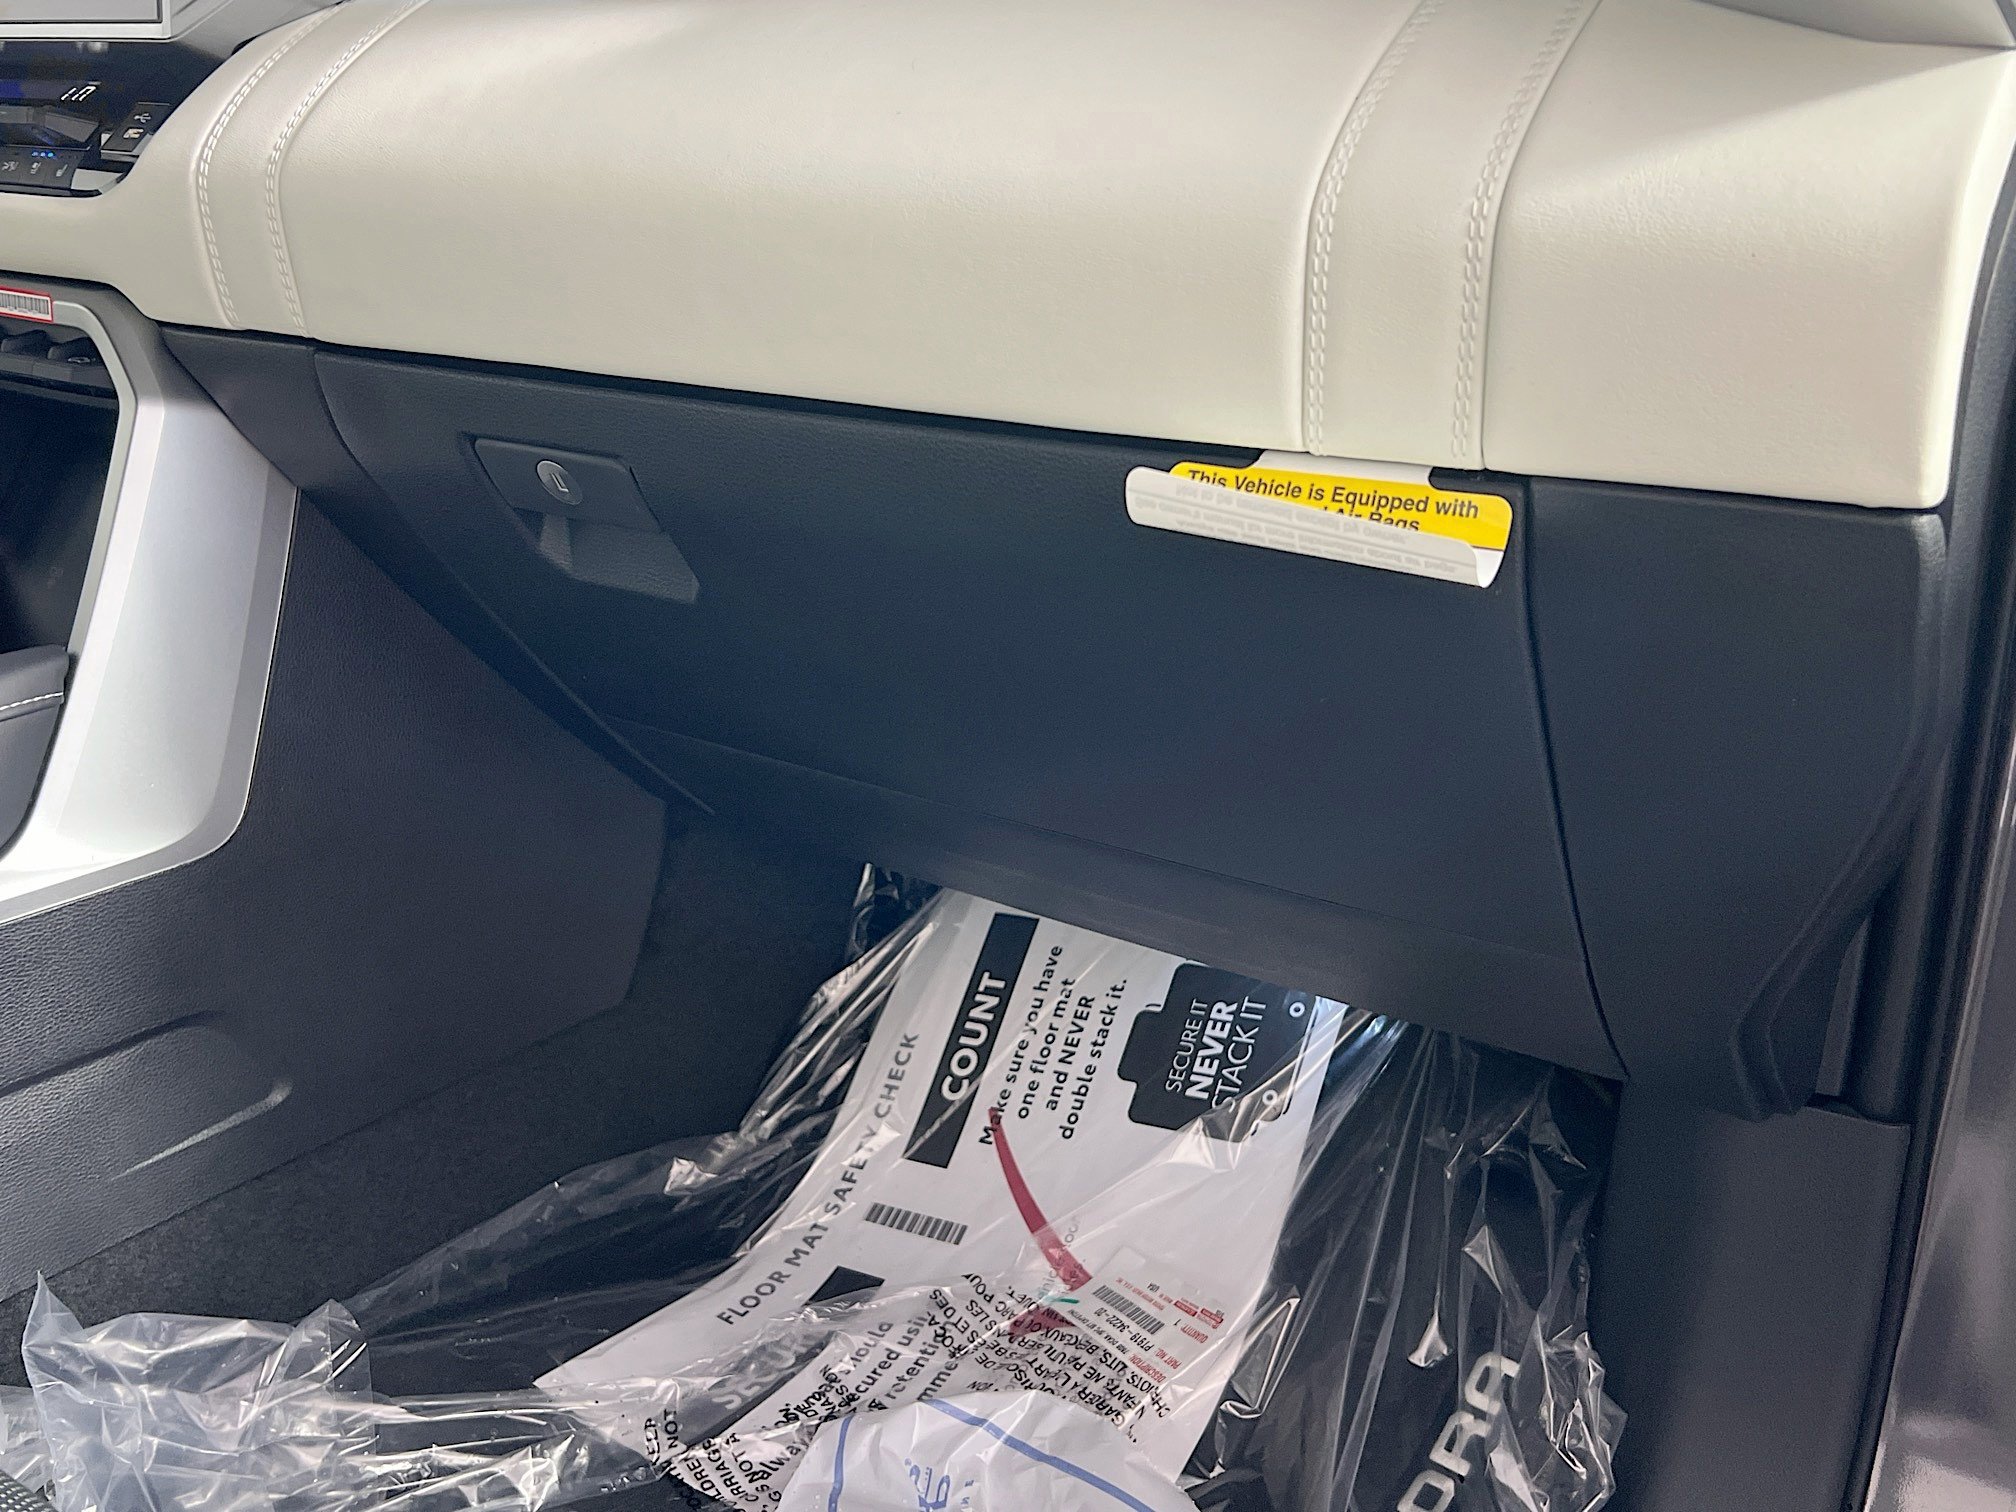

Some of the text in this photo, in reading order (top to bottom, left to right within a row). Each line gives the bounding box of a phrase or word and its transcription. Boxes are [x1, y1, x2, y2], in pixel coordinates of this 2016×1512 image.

[1188, 469, 1479, 519] This Vehicle is Equipped with
[941, 971, 1006, 1101] COUNT
[978, 945, 1063, 1145] Make sure you have
[1018, 977, 1076, 1119] one floor mat
[1046, 995, 1095, 1111] and NEVER
[1059, 978, 1127, 1140] double stack it.
[1165, 998, 1208, 1093] SECURE IT
[1184, 1000, 1238, 1100] NEVER
[1211, 995, 1267, 1113] STACK IT
[717, 1031, 919, 1326] FLOOR MAT SAFETY CHECK
[929, 1288, 957, 1320] DES
[953, 1316, 971, 1334] ET
[965, 1299, 991, 1324] LES
[974, 1351, 997, 1370] DE
[1083, 1365, 1108, 1384] NE
[1165, 1356, 1182, 1371] PART
[664, 1408, 679, 1449] NOT
[751, 1430, 813, 1481] alway
